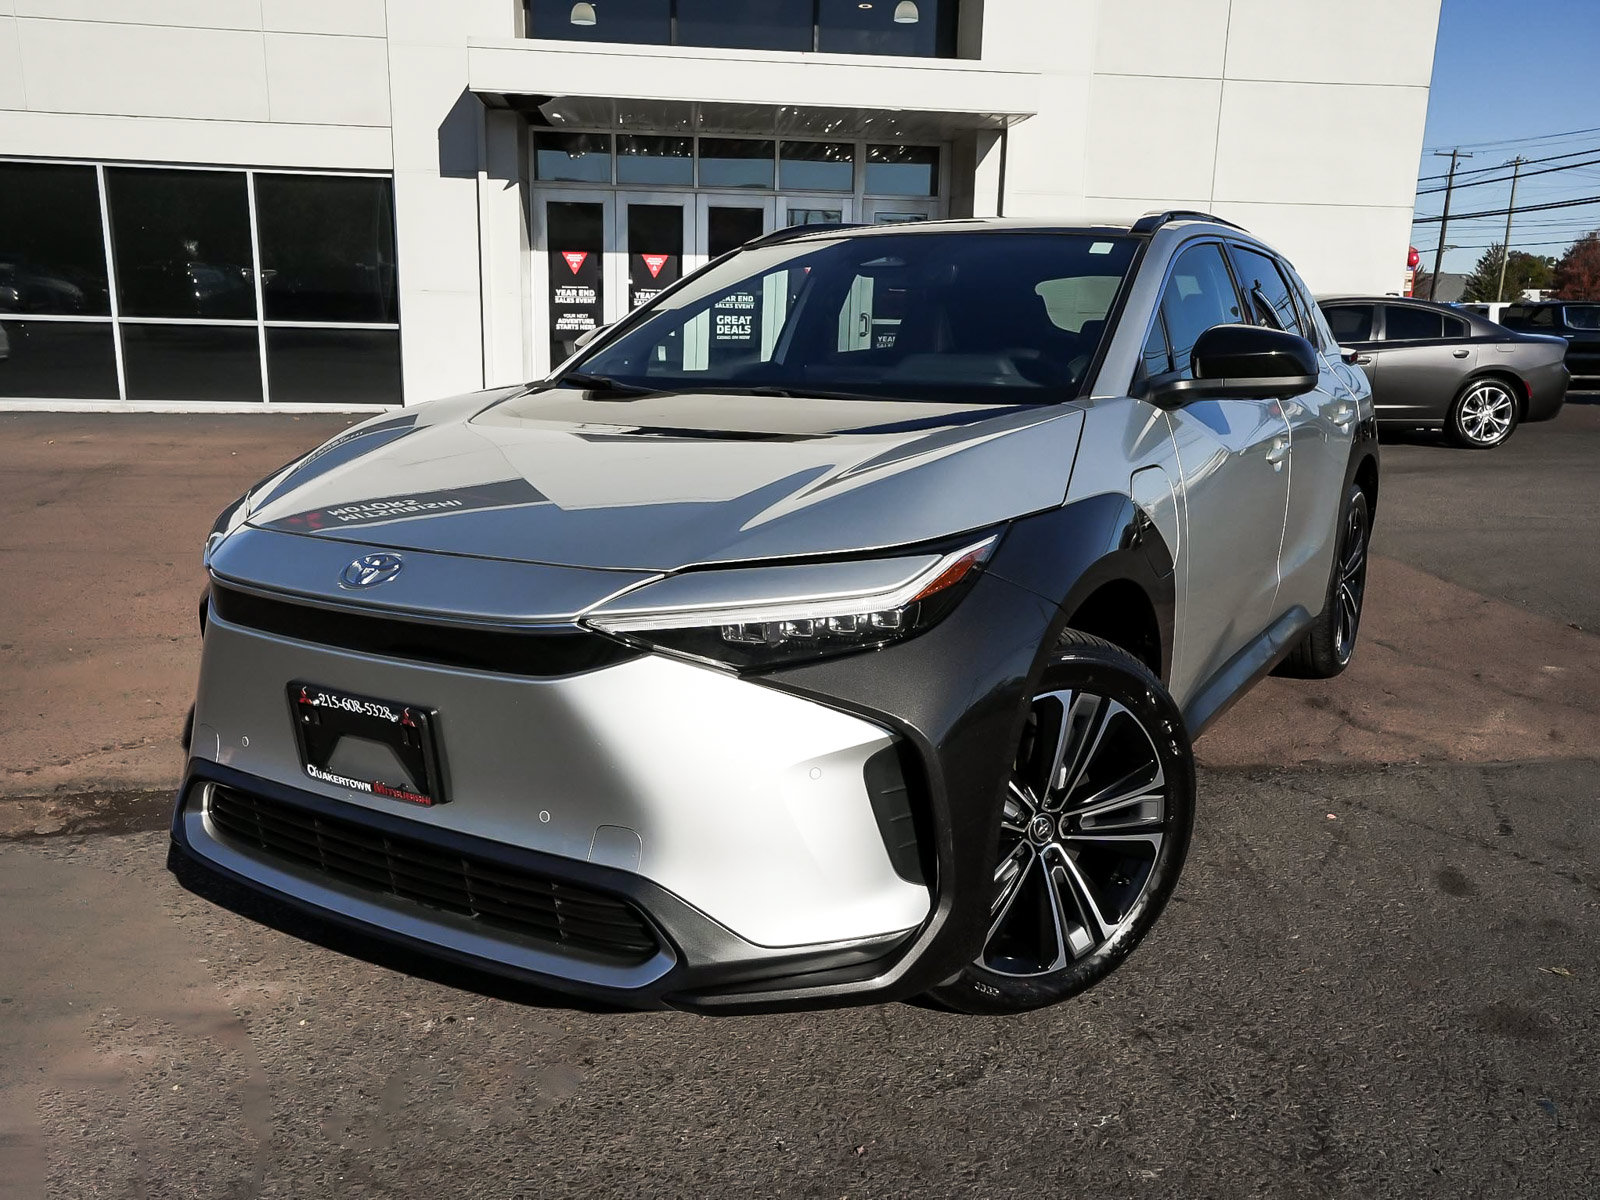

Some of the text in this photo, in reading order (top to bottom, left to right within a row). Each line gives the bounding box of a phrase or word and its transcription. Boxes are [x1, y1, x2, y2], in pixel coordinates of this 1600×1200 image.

[716, 315, 752, 325] GREAT
[716, 325, 752, 334] DEALS
[318, 693, 393, 720] 215-608-5328
[307, 764, 372, 792] QUAKERTOWN
